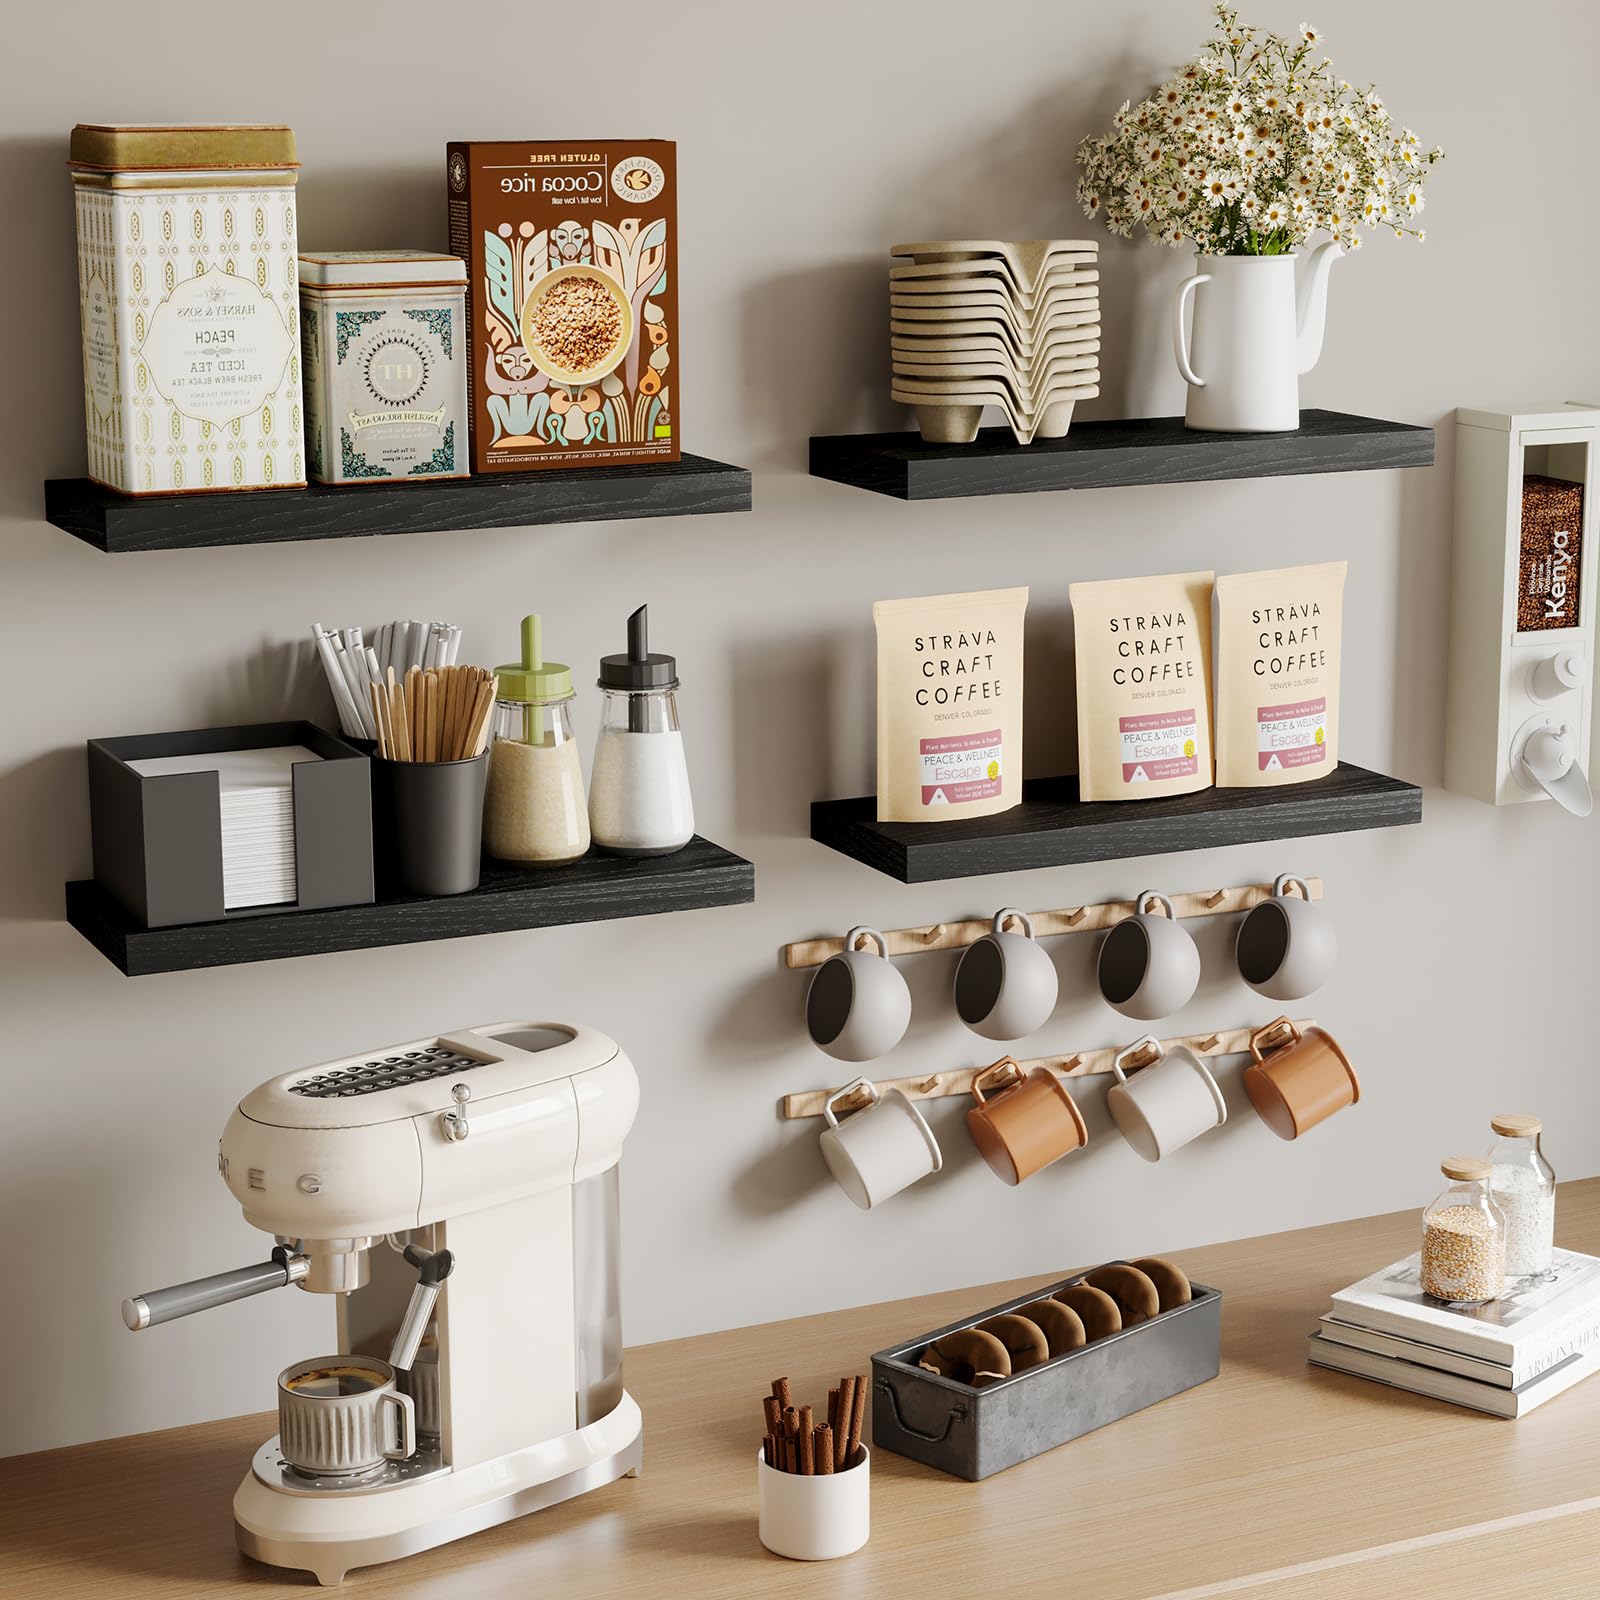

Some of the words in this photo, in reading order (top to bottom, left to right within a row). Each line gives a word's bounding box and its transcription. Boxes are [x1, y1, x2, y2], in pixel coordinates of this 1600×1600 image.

[1545, 531, 1572, 618] Kenya
[1110, 612, 1186, 632] STRÄVA
[1252, 603, 1320, 624] STRÄVA
[915, 630, 996, 651] STRÄVA
[1118, 636, 1184, 657] CRAFT
[1260, 626, 1318, 648] CRAFT
[922, 654, 992, 677] CRAFT
[1254, 650, 1325, 675] COFFEE
[1113, 661, 1193, 685] COFFEE
[916, 680, 1001, 706] COFFEE
[1270, 681, 1292, 690] DENVER
[1293, 677, 1319, 687] COLORADO
[1132, 691, 1155, 700] DENVER
[1157, 688, 1186, 697] COLORADO
[961, 708, 992, 718] COLORADO
[1124, 732, 1152, 743] PEACE
[1154, 732, 1160, 740] &
[1162, 726, 1195, 739] WELLNESS
[1261, 721, 1288, 732] PEACE
[1290, 721, 1294, 730] &
[1272, 732, 1310, 747] Escape
[924, 754, 954, 765] PEACE
[956, 754, 962, 763] &
[965, 747, 1000, 761] WELLNESS
[1136, 743, 1178, 758] Escape
[936, 766, 981, 781] Escape
